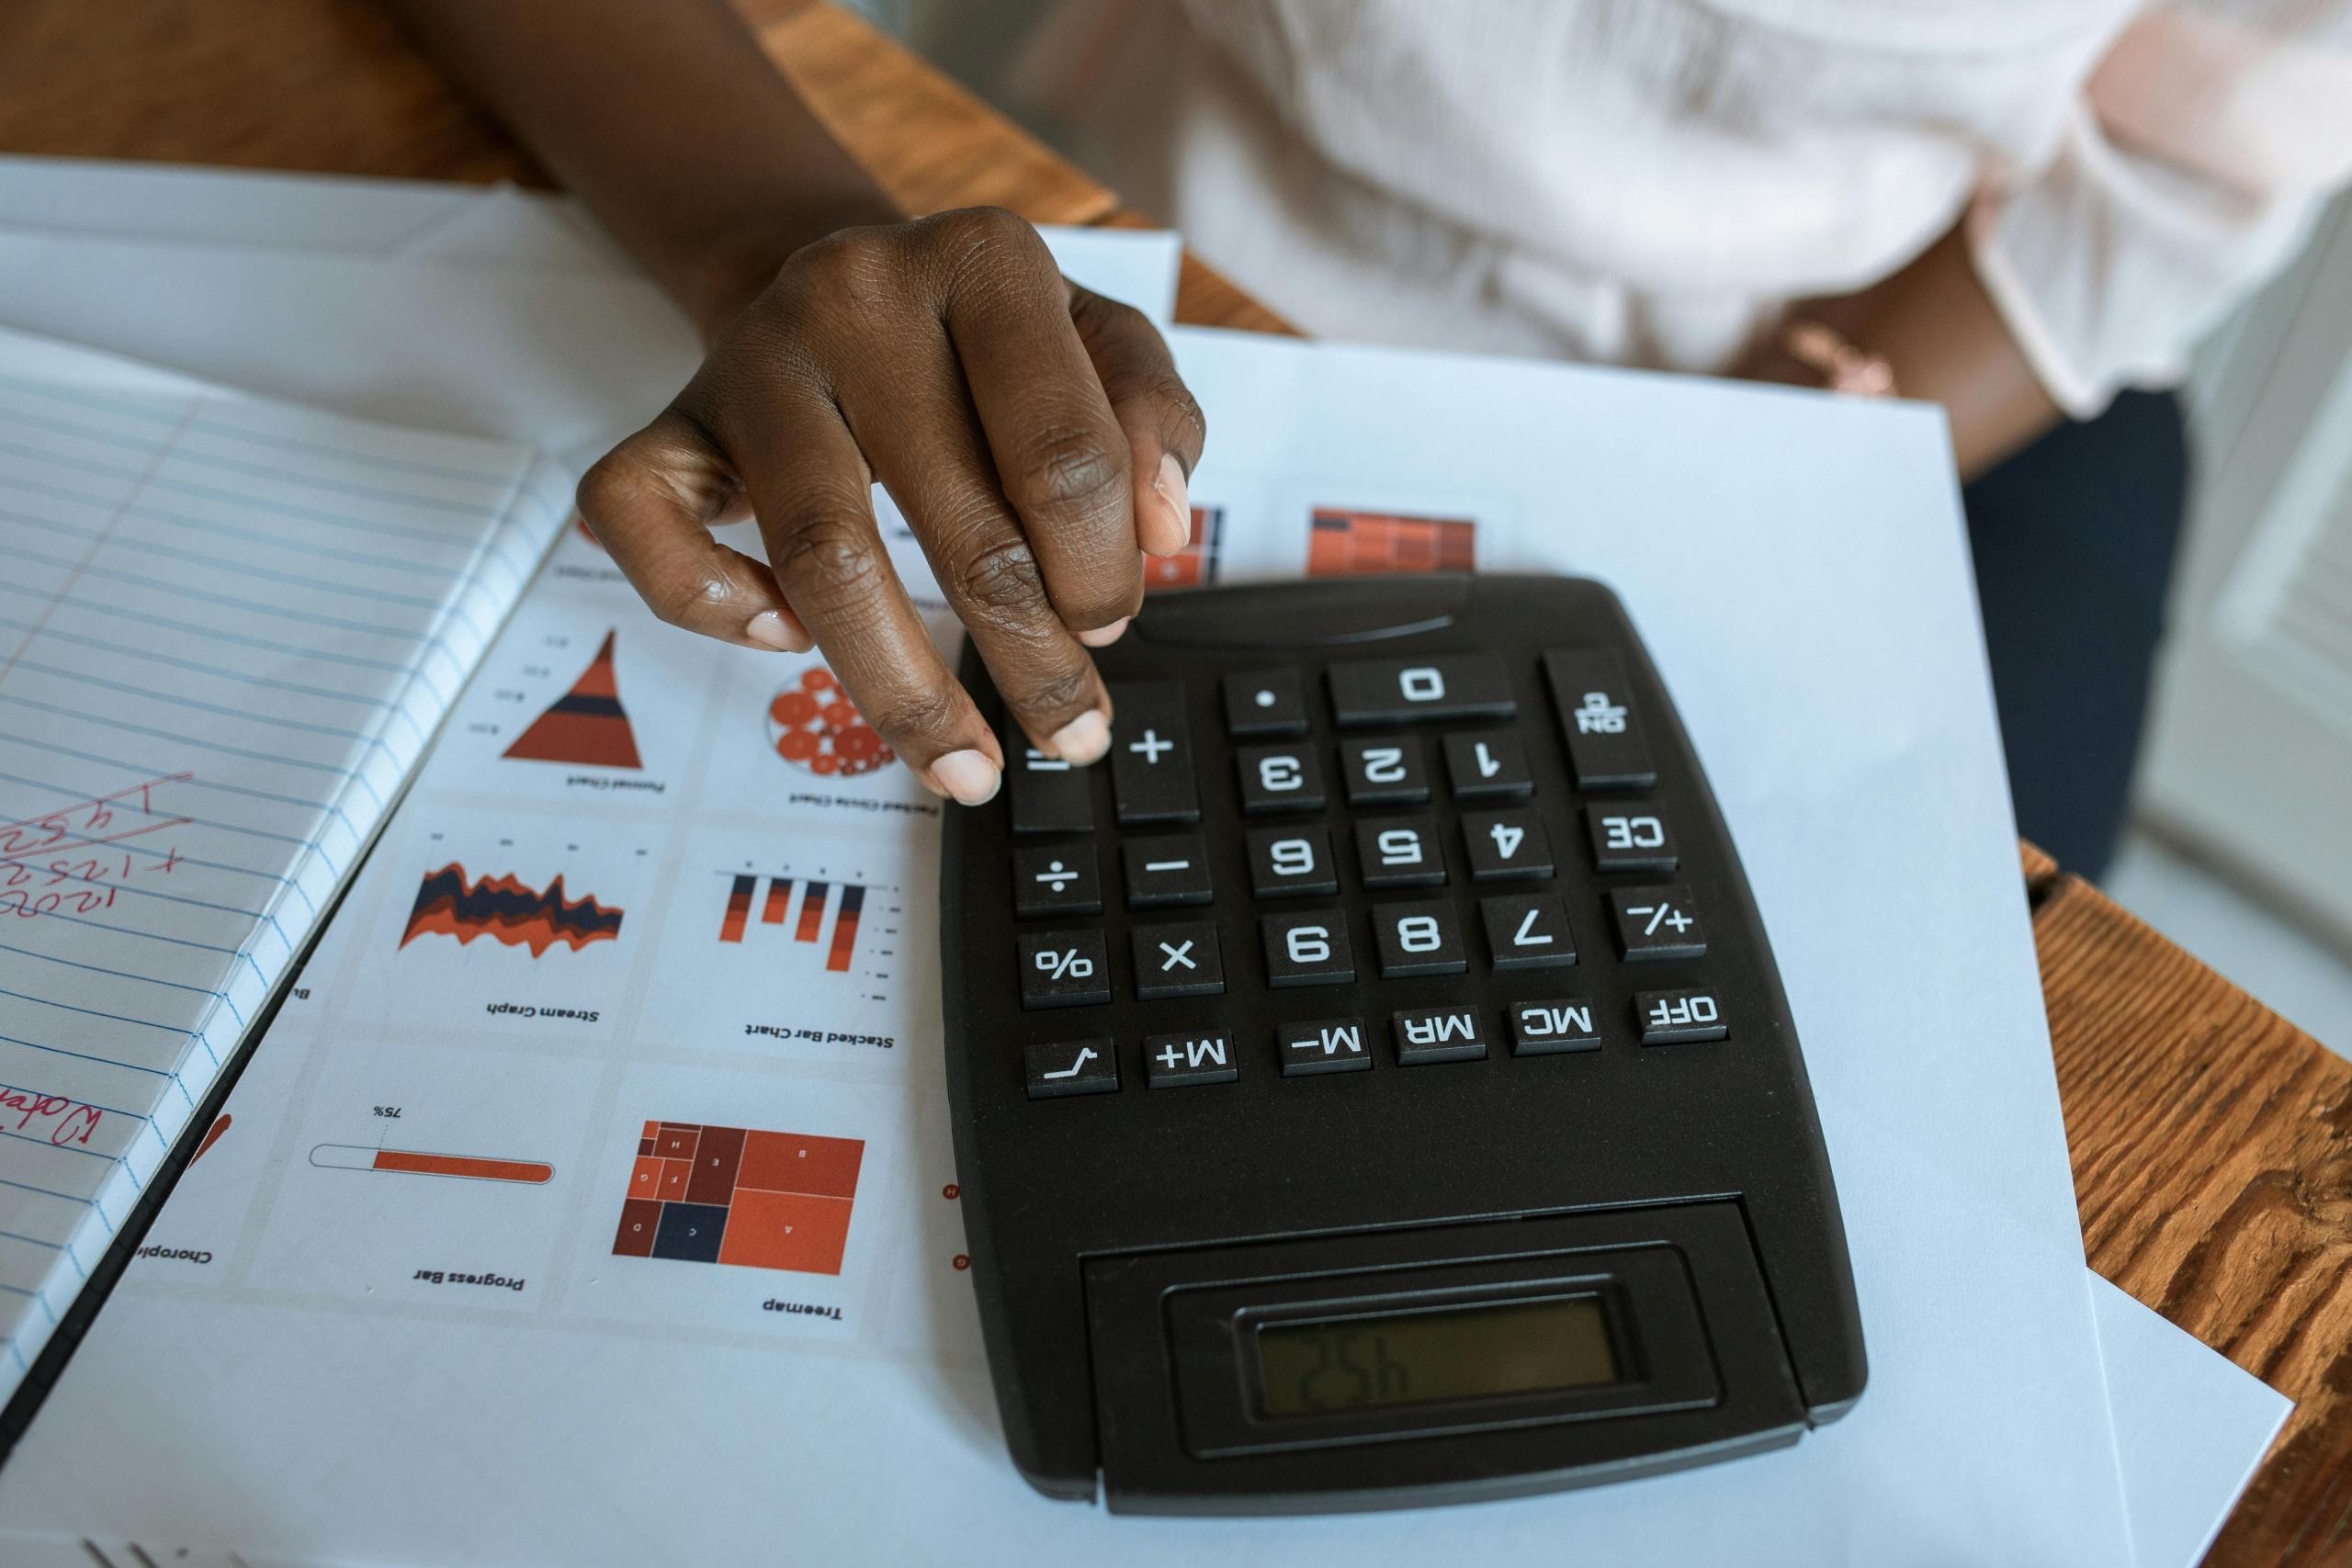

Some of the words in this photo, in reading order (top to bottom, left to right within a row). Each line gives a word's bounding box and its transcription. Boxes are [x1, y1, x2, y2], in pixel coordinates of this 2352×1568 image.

[1399, 668, 1445, 701] 0
[1259, 756, 1303, 791] 3
[1363, 748, 1406, 783] 2
[1476, 743, 1499, 777] 1
[566, 774, 609, 790] Chart
[612, 778, 665, 794] Funnel
[788, 793, 832, 807] Chart
[835, 797, 880, 813] Circle
[1378, 829, 1422, 865] 5
[1490, 823, 1524, 859] 4
[1601, 817, 1665, 849] CE
[1271, 839, 1315, 875] 6
[1397, 916, 1442, 953] 8
[1513, 909, 1554, 946] 7
[1286, 926, 1330, 963] 9
[1035, 948, 1093, 980] %
[485, 1001, 537, 1019] Graph
[539, 1007, 600, 1023] Stream
[1521, 1006, 1592, 1035] MC
[1649, 995, 1718, 1023] OFF
[744, 1024, 792, 1040] Chart
[795, 1028, 822, 1043] Bar
[826, 1032, 895, 1050] Stacked
[1404, 1014, 1475, 1044] MR
[1156, 1038, 1227, 1068] M+
[372, 1105, 402, 1120] 75%
[413, 1269, 447, 1285] Bar
[448, 1269, 526, 1292] Progress
[762, 1299, 843, 1321] Treemap
[1297, 1333, 1412, 1409] 452
